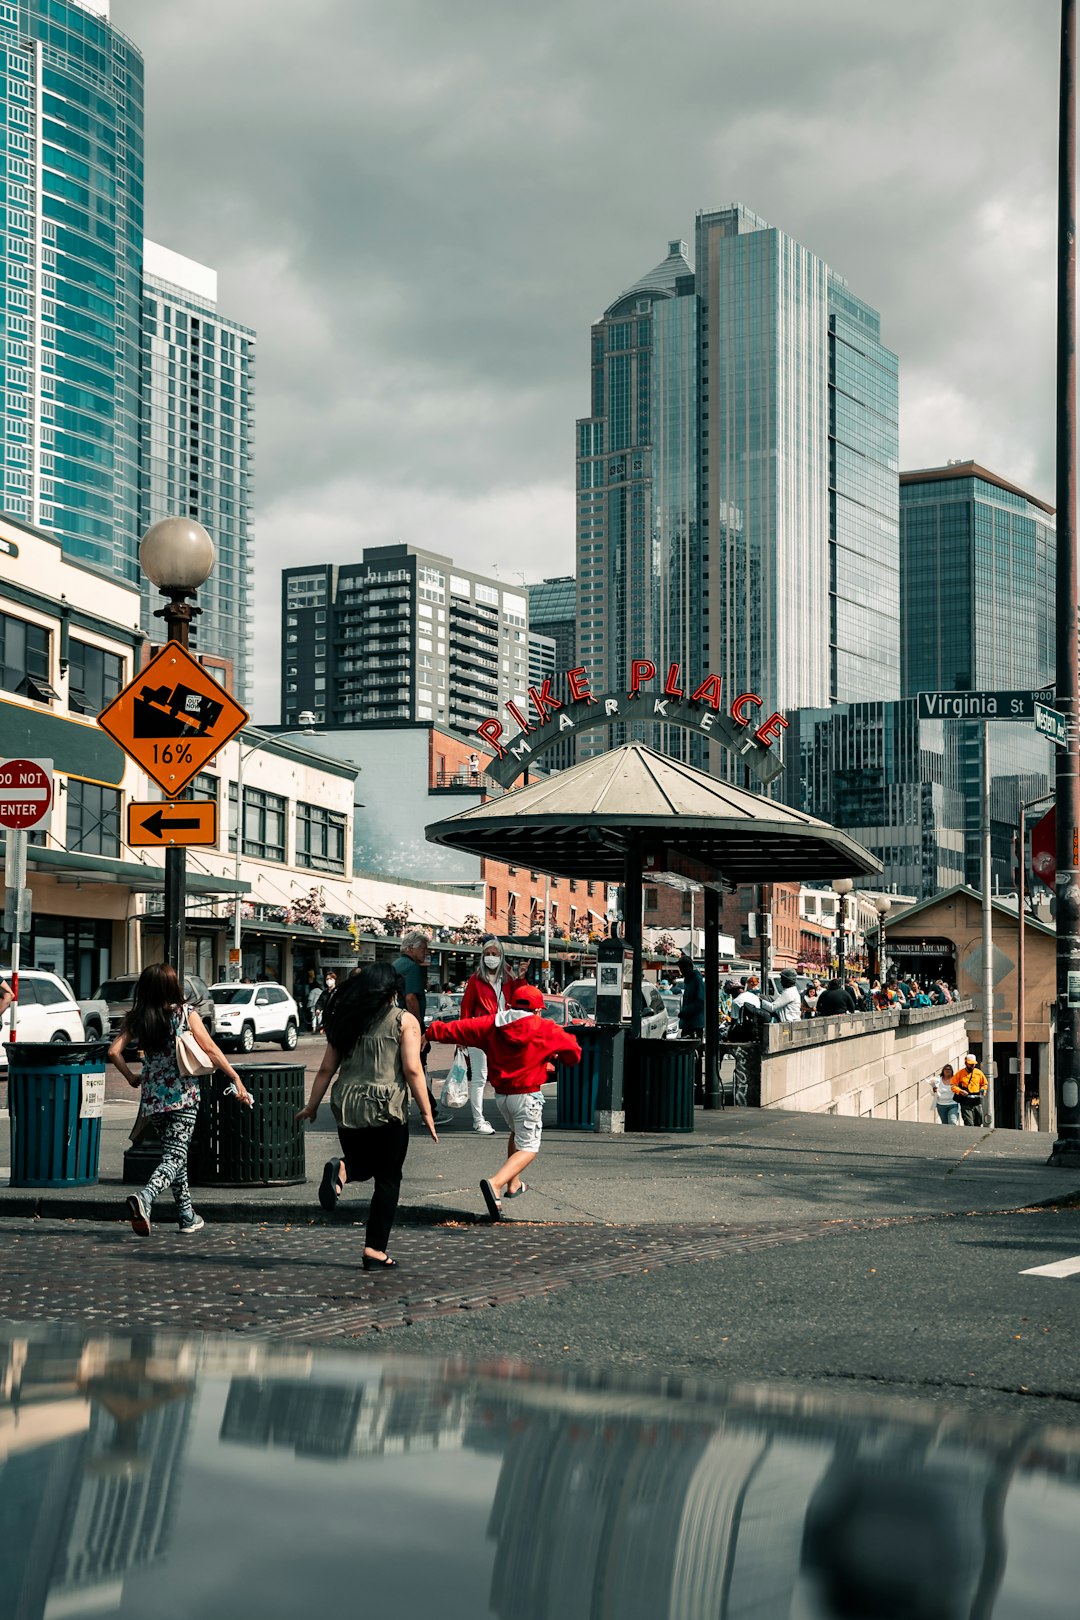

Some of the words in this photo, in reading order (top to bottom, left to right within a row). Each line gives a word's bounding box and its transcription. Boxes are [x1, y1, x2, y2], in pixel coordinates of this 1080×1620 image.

[475, 665, 592, 758] PIKE
[631, 658, 789, 748] PLACE
[924, 693, 997, 717] Virginia
[1010, 698, 1024, 713] St
[1031, 691, 1052, 701] 1900
[510, 697, 758, 762] MARKET
[1035, 705, 1056, 735] Western
[153, 743, 193, 764] 16%
[19, 773, 42, 784] NOT
[1, 804, 37, 815] ENTER
